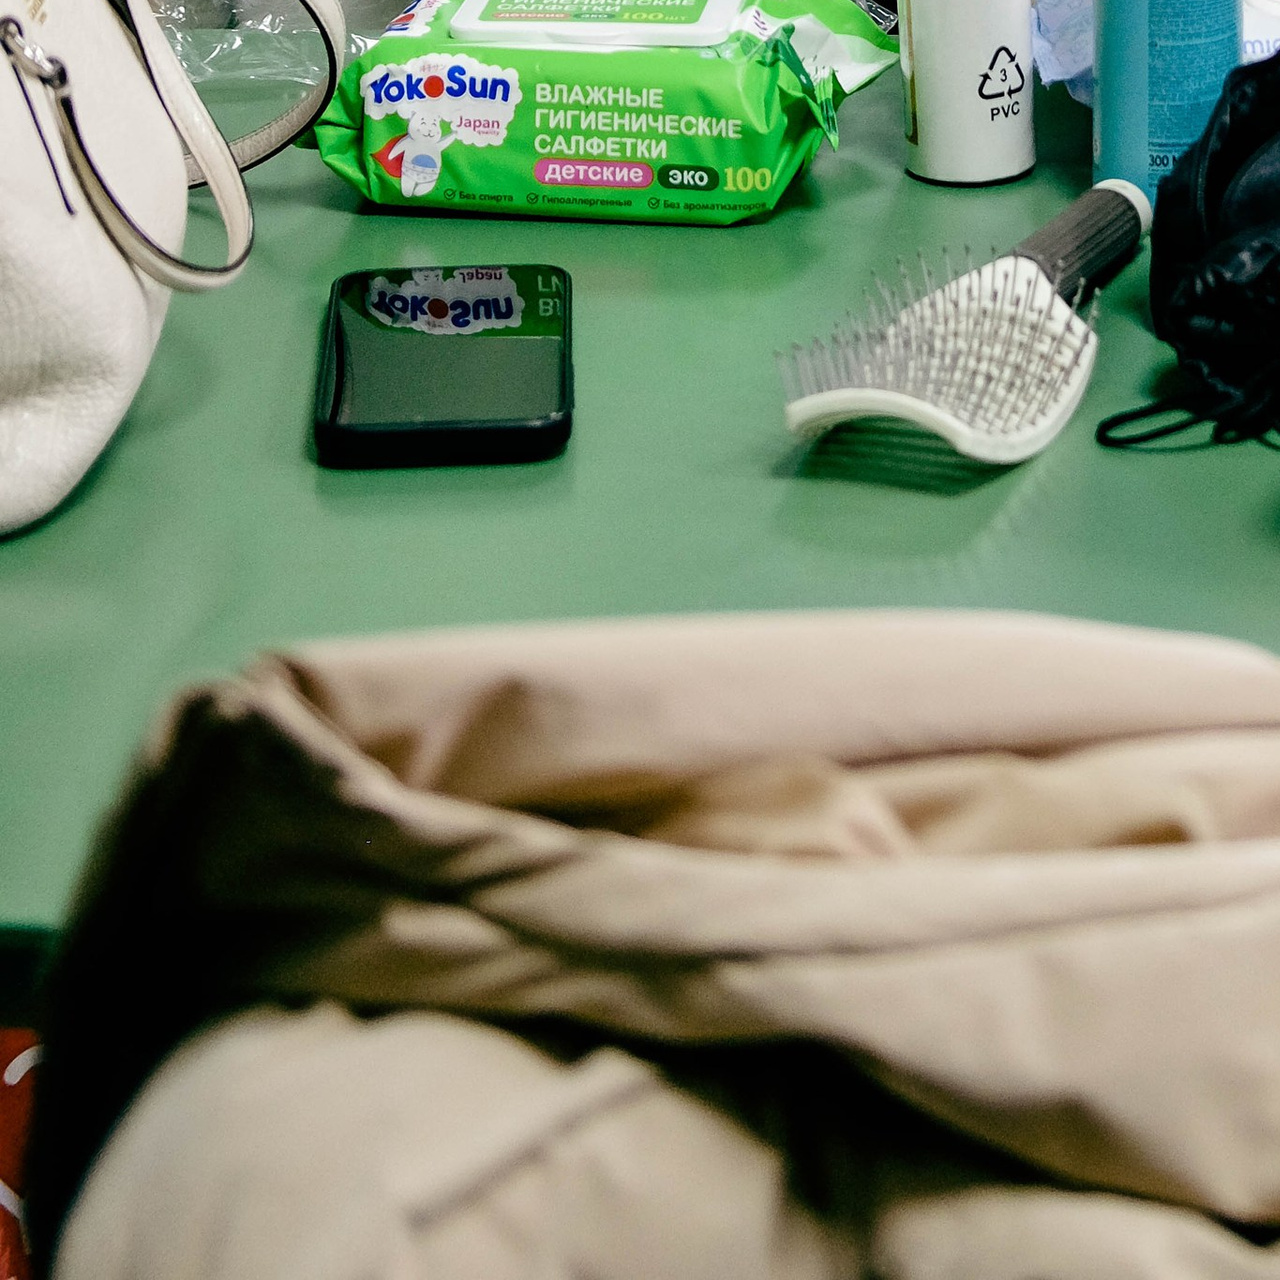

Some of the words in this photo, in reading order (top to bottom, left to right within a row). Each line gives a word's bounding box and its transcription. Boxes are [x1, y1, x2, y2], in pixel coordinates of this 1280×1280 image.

[496, 4, 621, 13] САЛФЕТКИ
[999, 68, 1008, 83] 3
[534, 83, 665, 109] ВЛАЖНЫЕ
[989, 100, 1021, 122] PVC
[456, 115, 500, 132] Japan
[534, 109, 743, 139] ГИГИЕНИЧЕСКИЕ
[533, 133, 668, 159] САЛФЕТКИ
[1148, 154, 1170, 168] 300
[543, 159, 645, 183] детские
[668, 169, 709, 186] эко
[723, 166, 772, 192] 100
[458, 190, 476, 200] Без
[479, 192, 514, 203] спирта
[541, 194, 633, 207] Гипоаллергенные
[663, 199, 681, 209] Без
